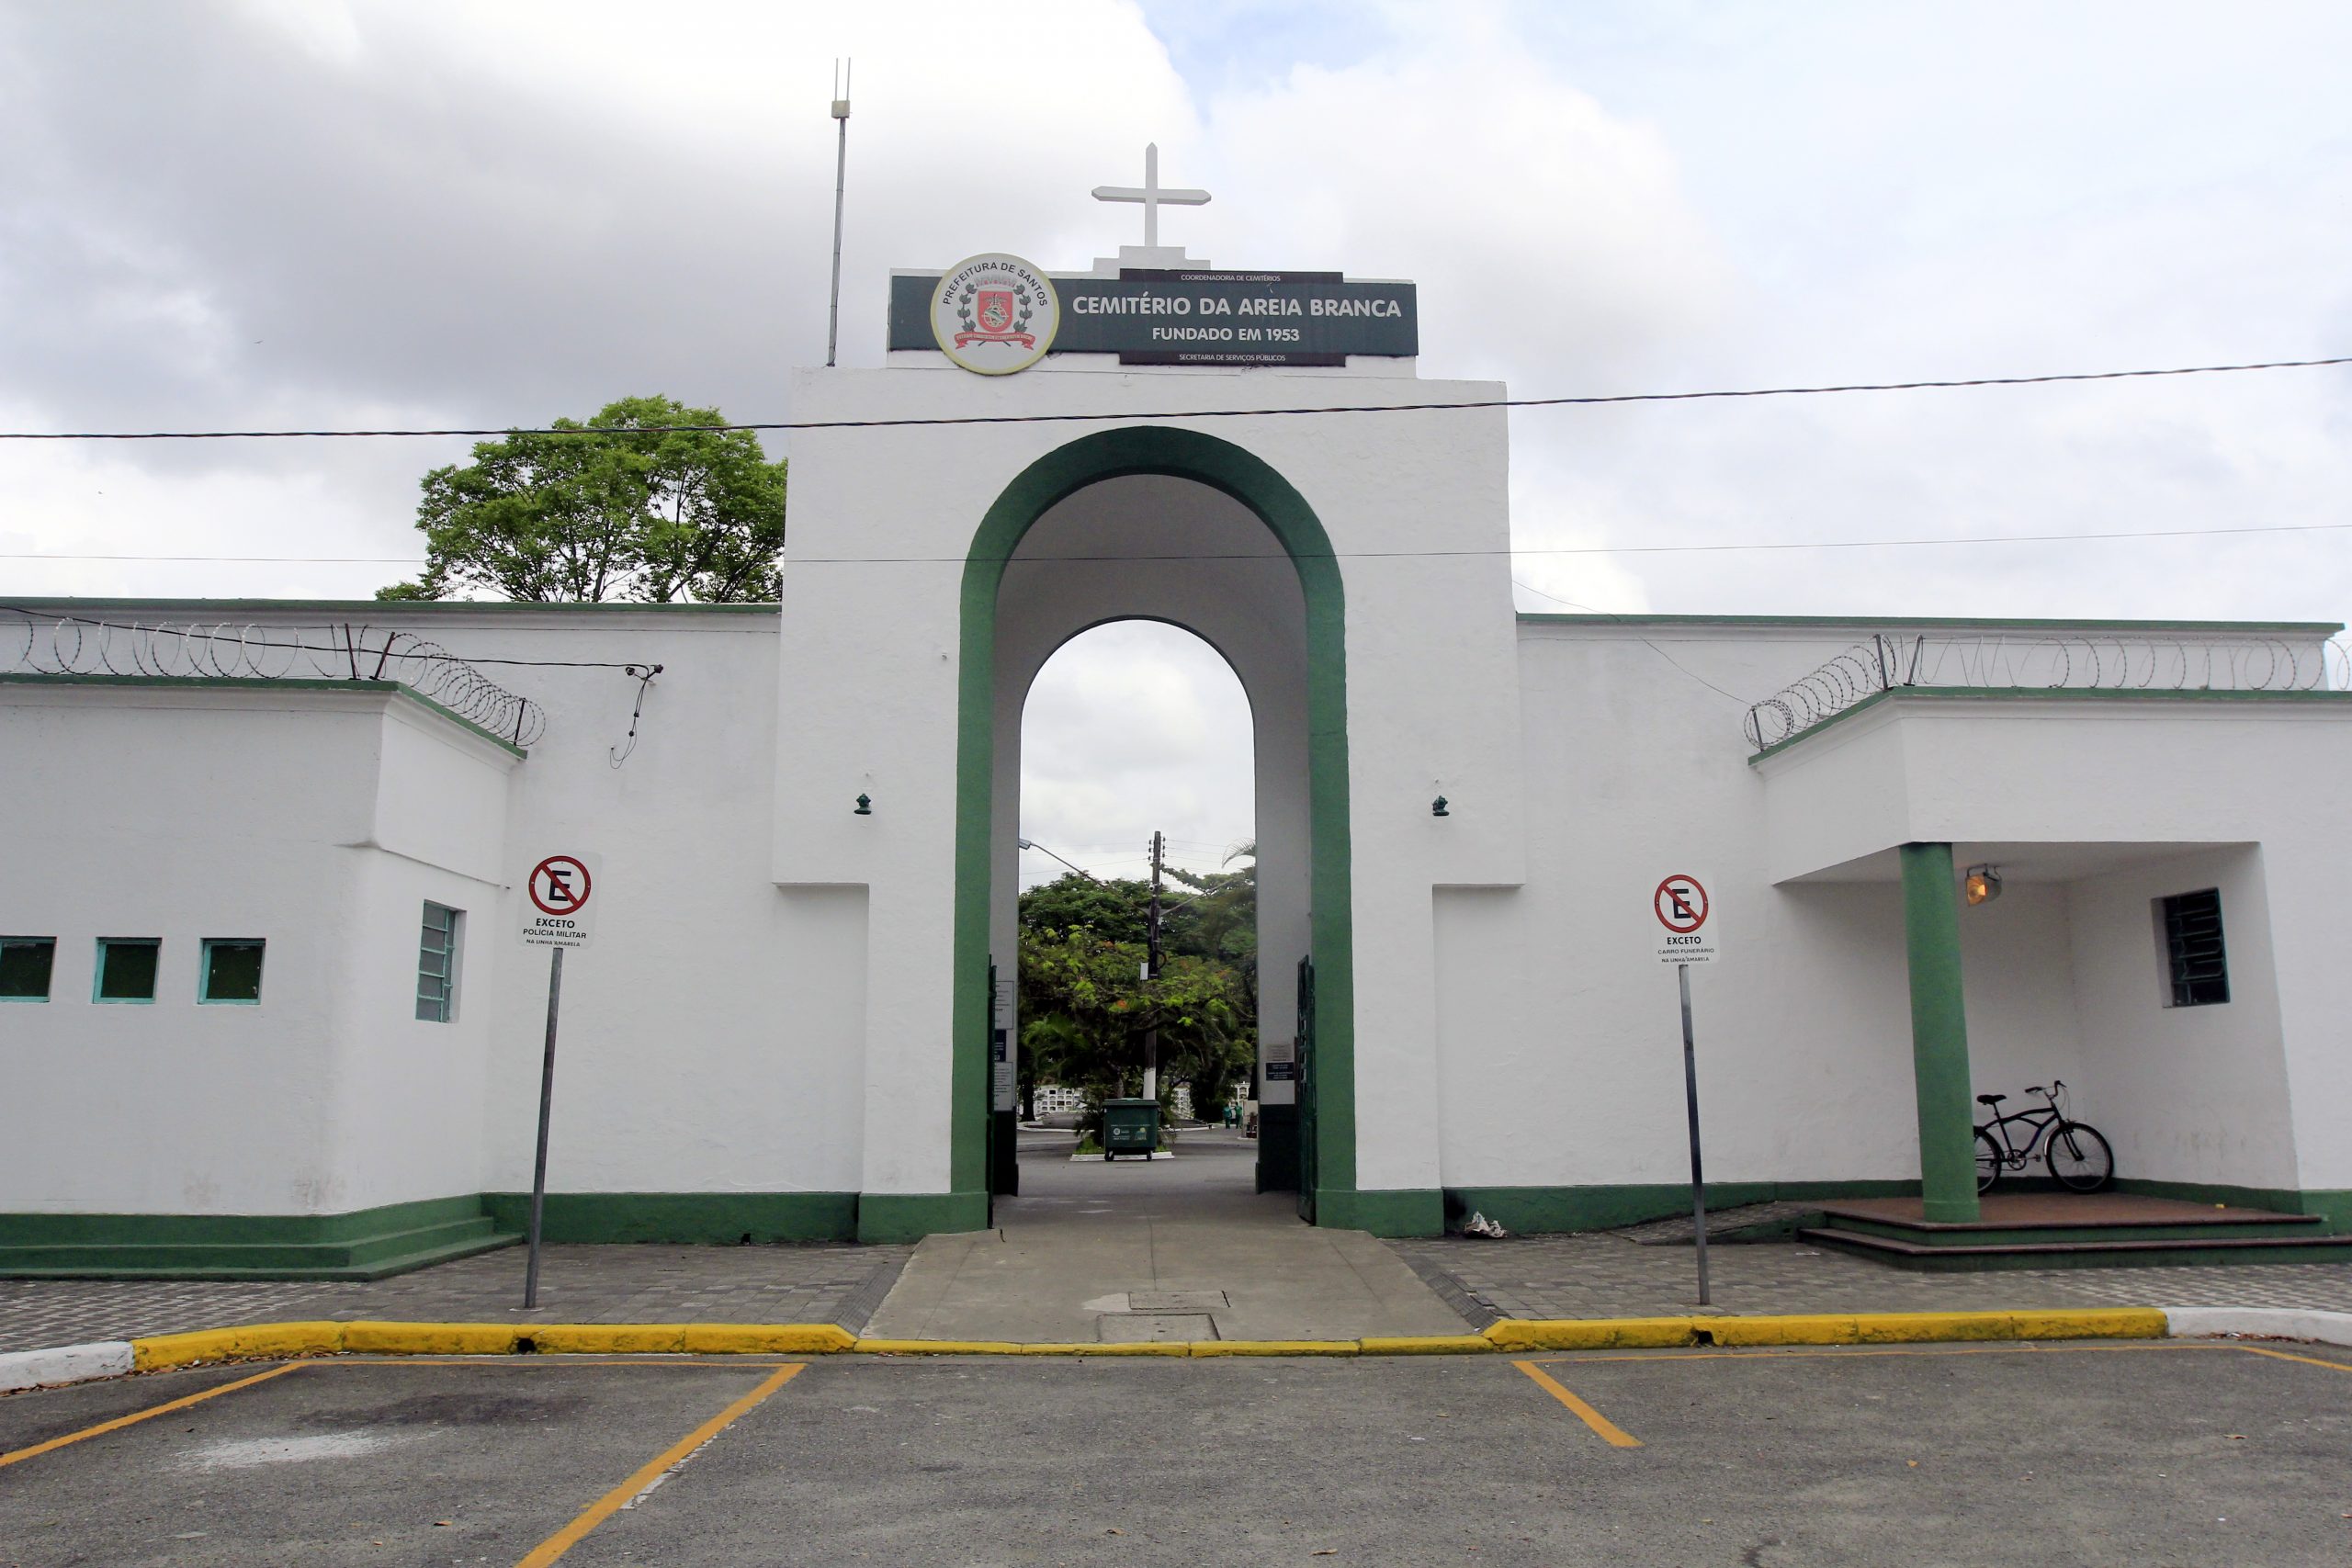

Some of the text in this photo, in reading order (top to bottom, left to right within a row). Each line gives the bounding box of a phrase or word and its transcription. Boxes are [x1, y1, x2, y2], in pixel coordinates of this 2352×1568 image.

[943, 262, 1048, 307] PREFEITURA DE SANTOS
[1181, 274, 1236, 282] COORDENADORIA
[1245, 274, 1281, 282] CEMITÉRIOS
[1072, 291, 1402, 318] CEMITÉRIO DA AREIA BRANCA
[1152, 327, 1300, 342] FUNDADO EM 1953
[1226, 354, 1255, 362] SERVIÇOS
[1256, 354, 1286, 362] PÚBLICOS
[548, 870, 571, 902] E
[1671, 888, 1691, 919] E
[536, 918, 575, 929] EXCETO
[523, 928, 587, 939] POLÍCIA MILITAR
[1667, 936, 1702, 945] EXCETO
